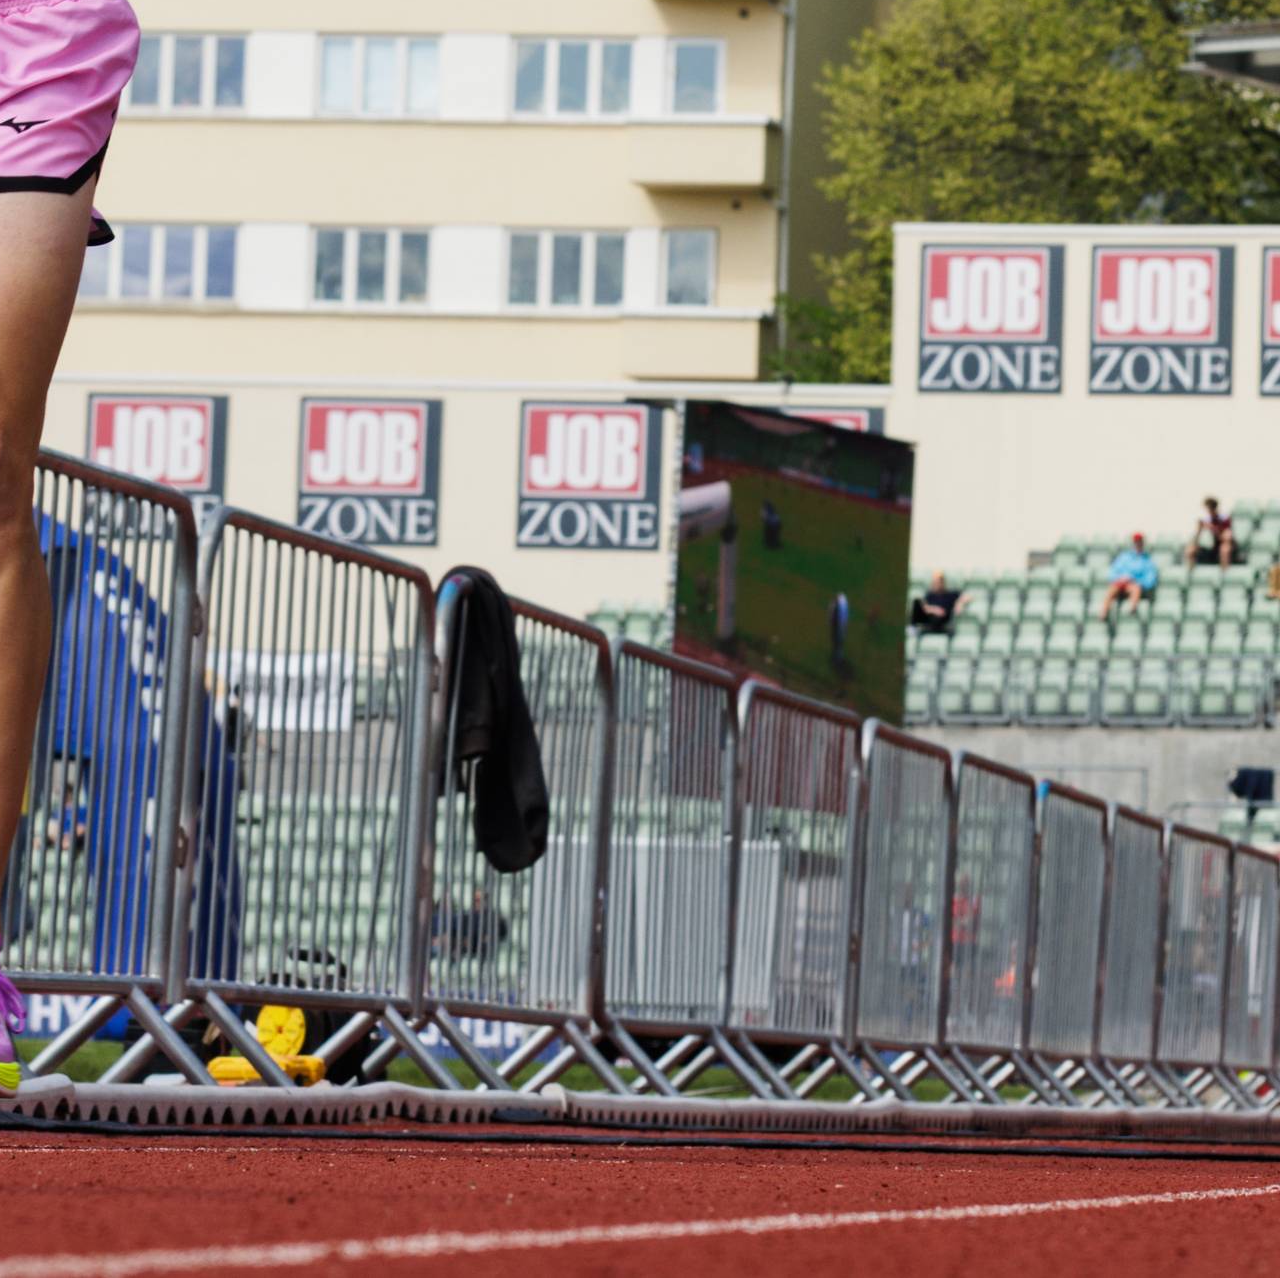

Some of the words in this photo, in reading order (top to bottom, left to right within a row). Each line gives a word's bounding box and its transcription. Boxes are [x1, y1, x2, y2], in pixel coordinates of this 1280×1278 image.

[930, 256, 1042, 333] JOB
[1101, 257, 1213, 334] JOB
[918, 344, 1060, 391] ZONE
[1090, 345, 1230, 392] ZONE
[96, 405, 206, 482] JOB
[308, 410, 418, 485] JOB
[529, 413, 640, 490] JOB
[299, 497, 436, 543] ZONE
[519, 500, 658, 548] ZONE
